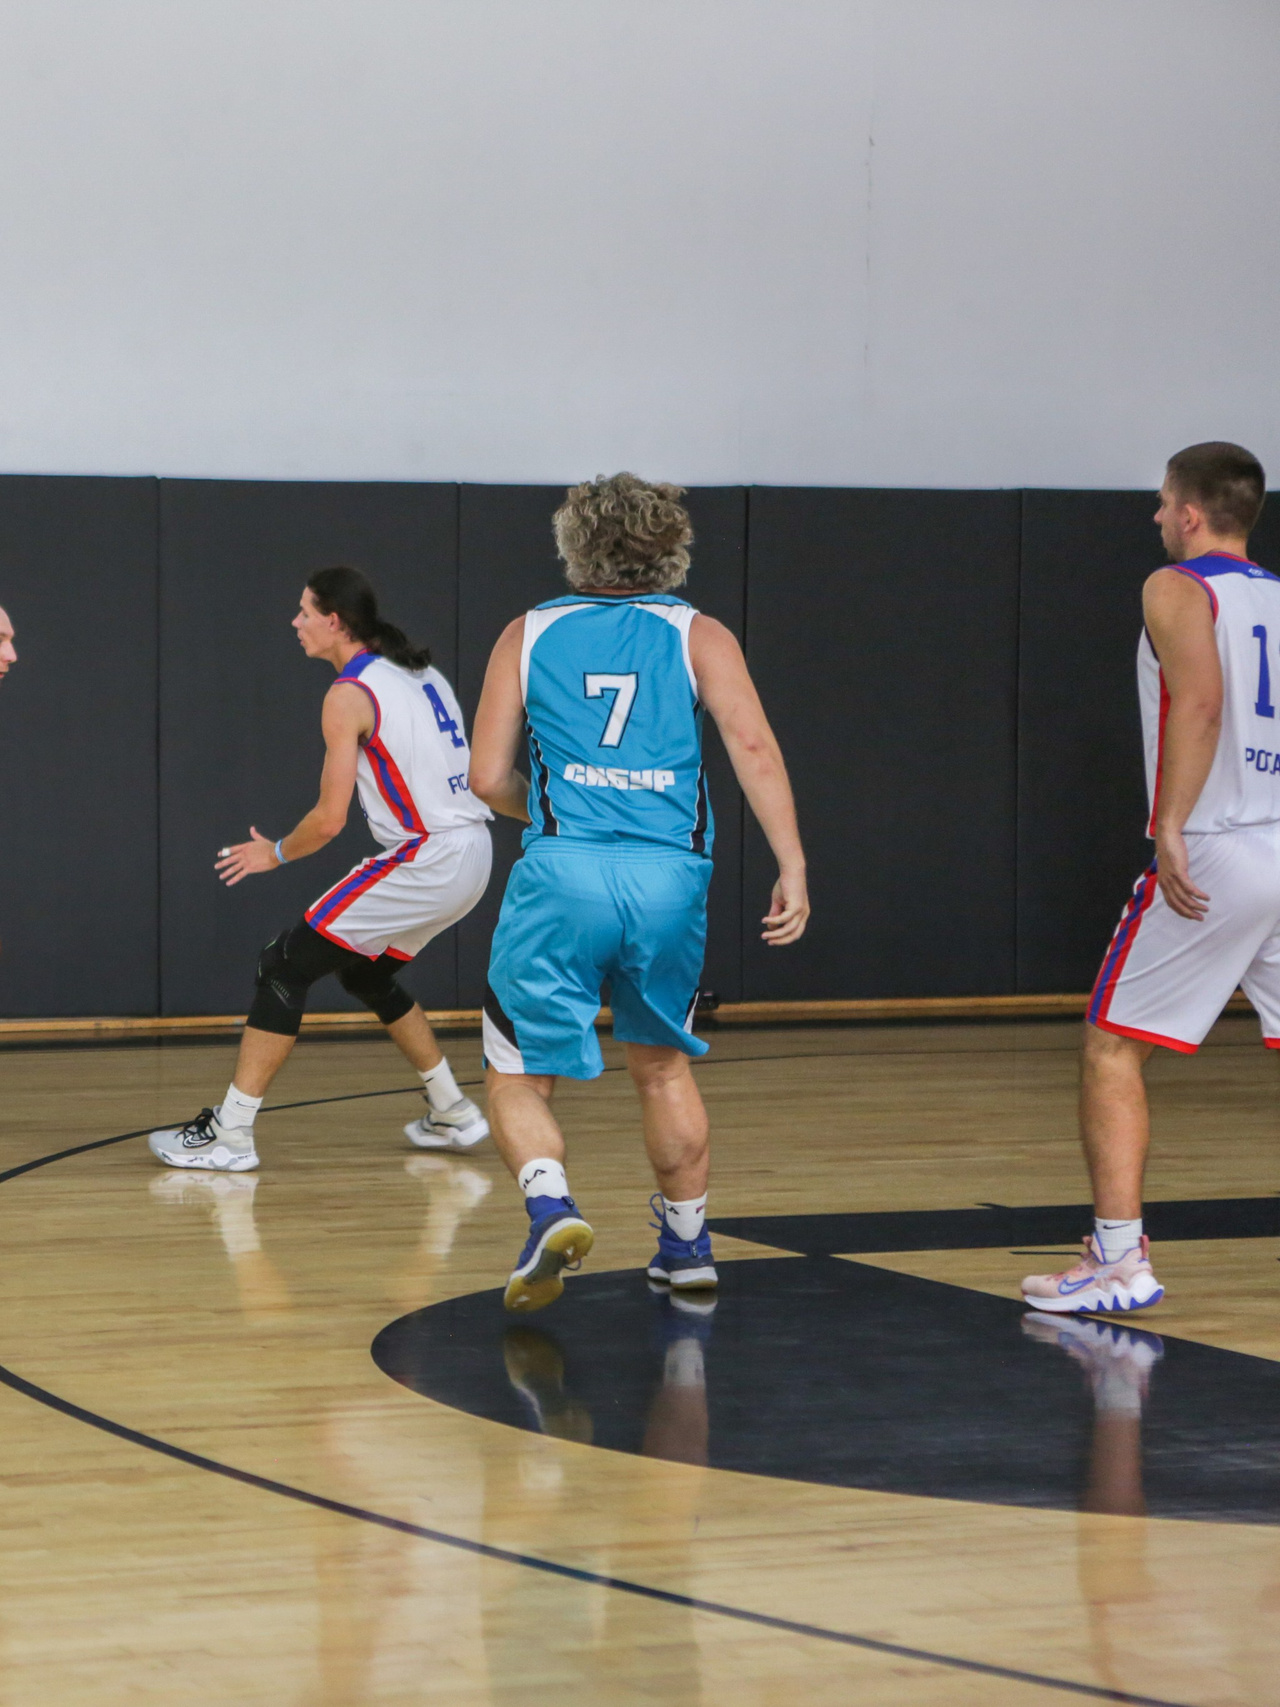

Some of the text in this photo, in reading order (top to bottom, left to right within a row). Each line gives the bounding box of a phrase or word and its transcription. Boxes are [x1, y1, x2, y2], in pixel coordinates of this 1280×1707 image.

[422, 683, 466, 749] 4
[583, 672, 639, 749] 7
[563, 763, 676, 792] СИБУР
